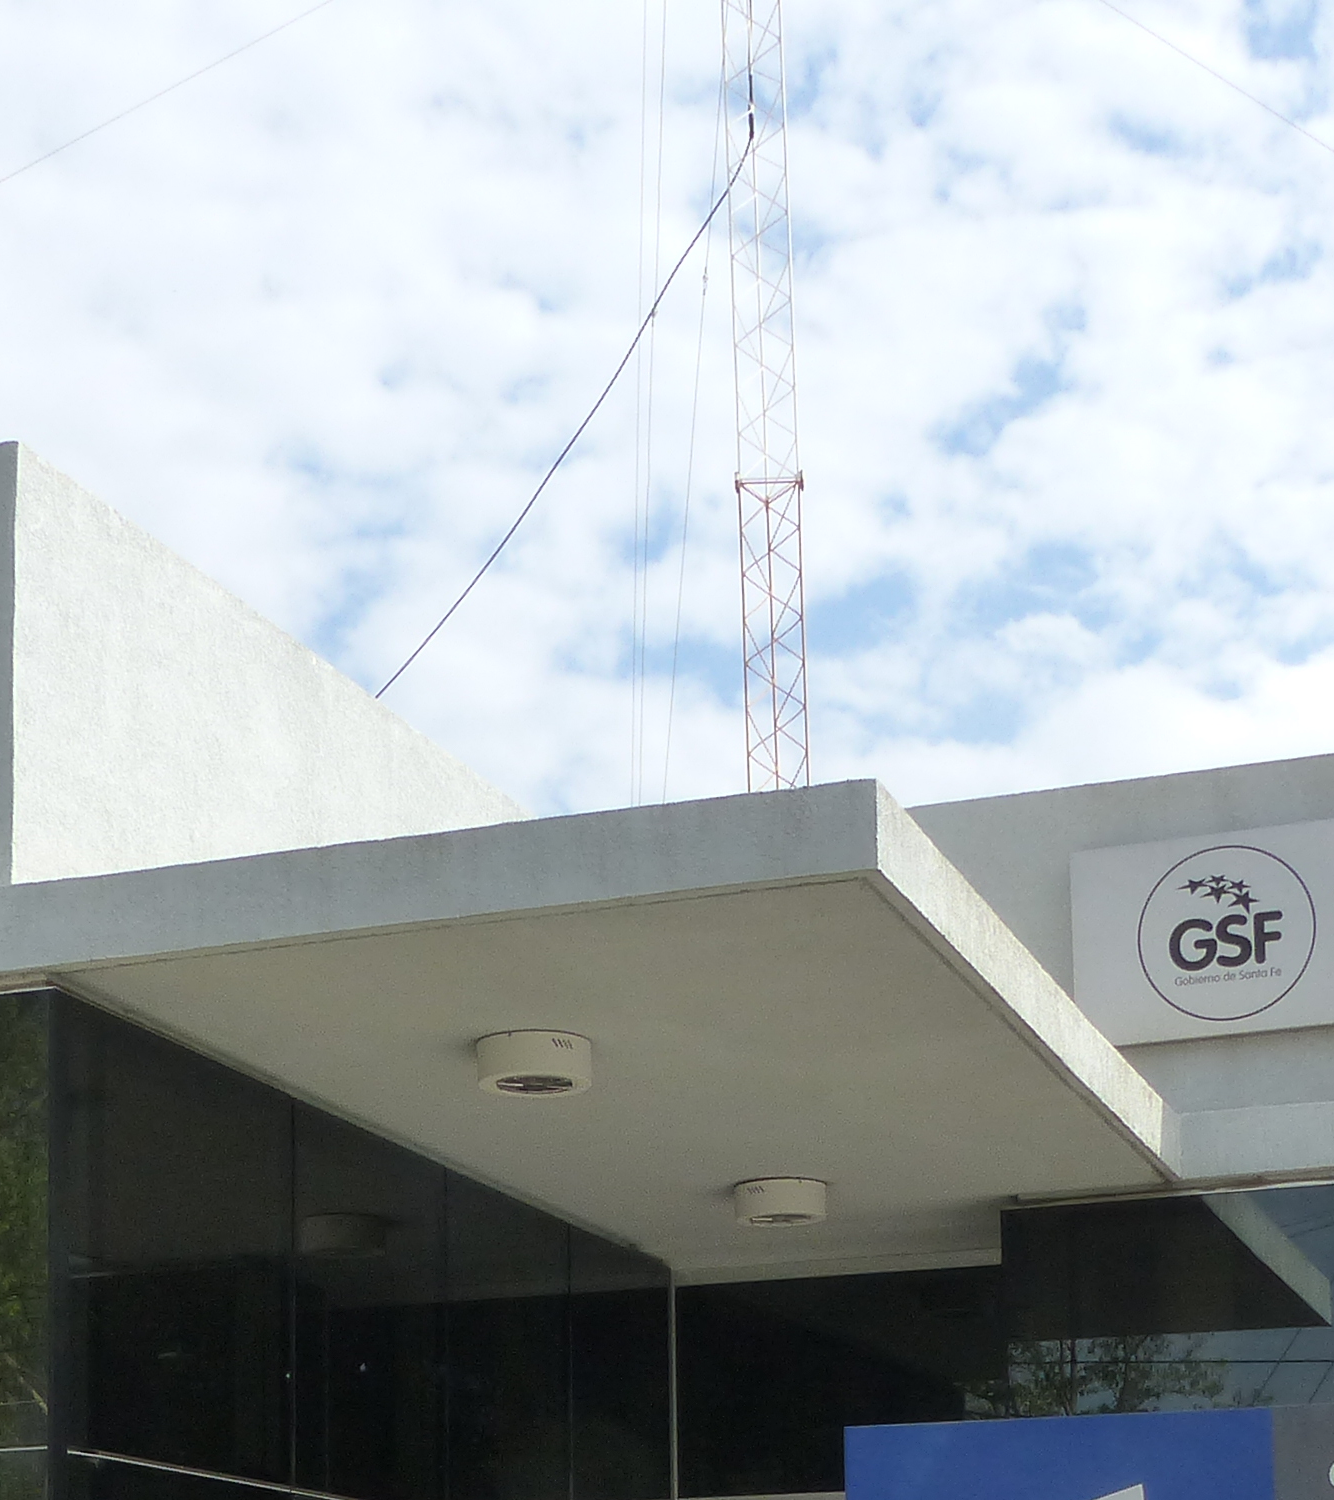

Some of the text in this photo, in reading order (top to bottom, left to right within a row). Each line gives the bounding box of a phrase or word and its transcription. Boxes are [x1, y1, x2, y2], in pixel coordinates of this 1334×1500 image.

[1169, 910, 1283, 972] GSF
[1174, 966, 1282, 987] Gobierno de Santa Fe
